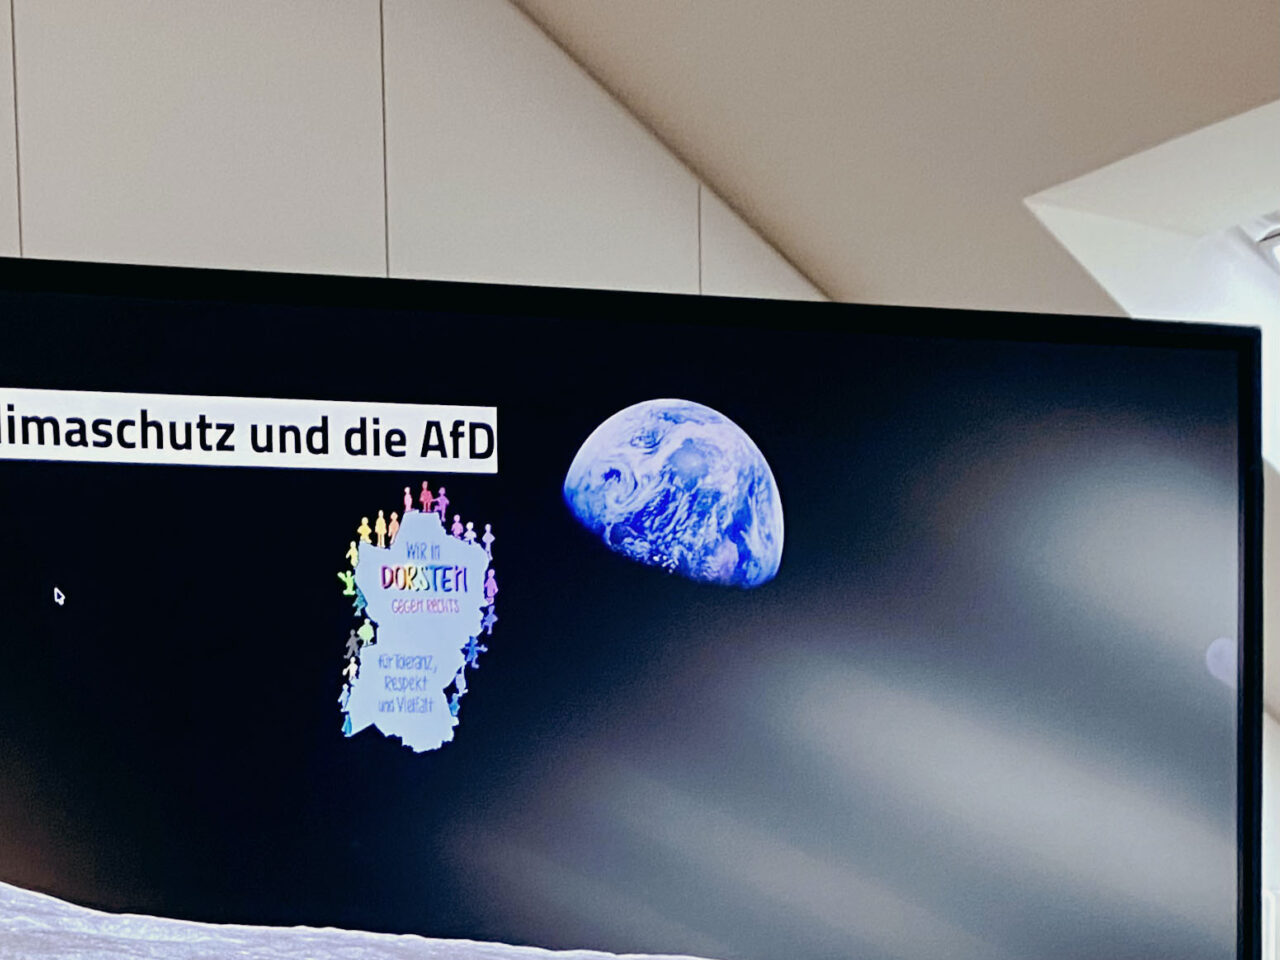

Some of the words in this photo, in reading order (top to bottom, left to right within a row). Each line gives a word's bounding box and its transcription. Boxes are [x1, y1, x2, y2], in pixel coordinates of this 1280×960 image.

[250, 415, 329, 455] und
[344, 416, 407, 458] die
[420, 420, 495, 460] AfD
[381, 564, 468, 592] DORSTEN
[384, 675, 428, 692] Respekt
[396, 696, 435, 713] Vielfalt
